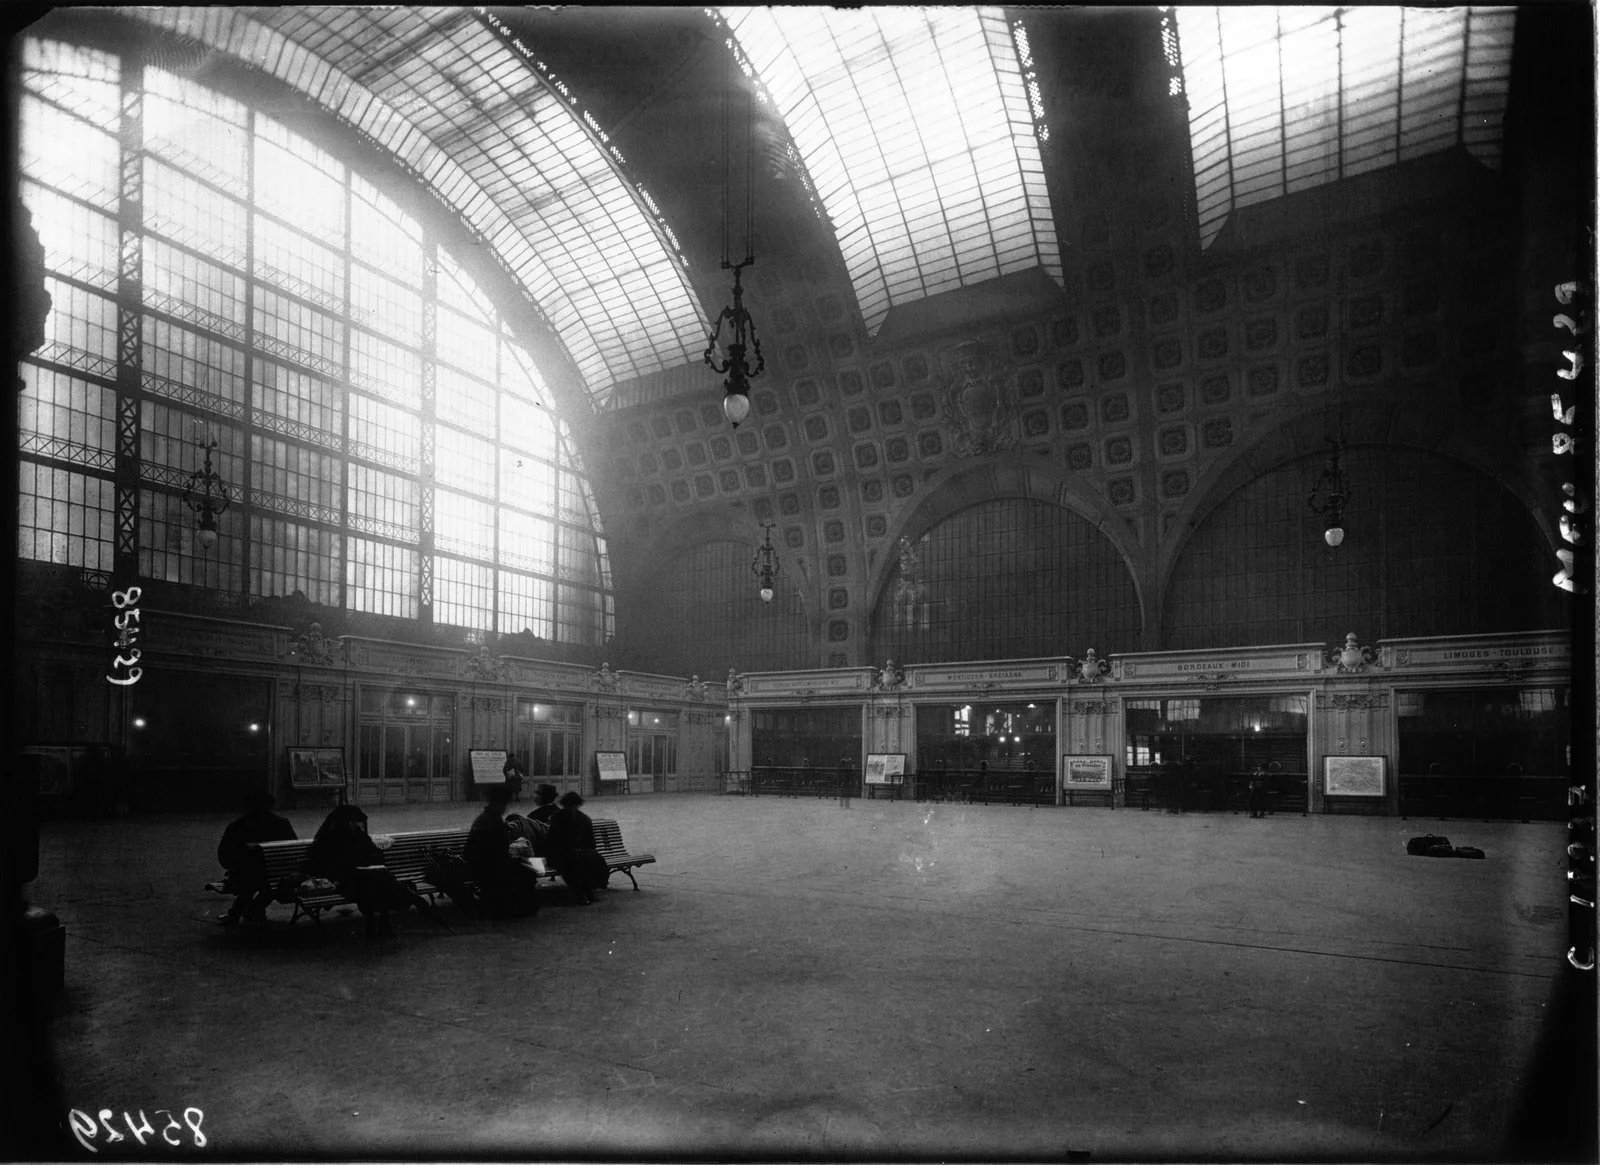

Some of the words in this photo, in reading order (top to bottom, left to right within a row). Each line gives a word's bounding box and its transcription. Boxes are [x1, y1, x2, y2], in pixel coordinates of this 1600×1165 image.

[1443, 650, 1489, 659] LIMOGES
[1500, 647, 1554, 657] TOULOUSE
[1177, 663, 1223, 671] BORDEAUX
[1231, 661, 1250, 669] MIDI
[989, 671, 1022, 679] BRETAGNE
